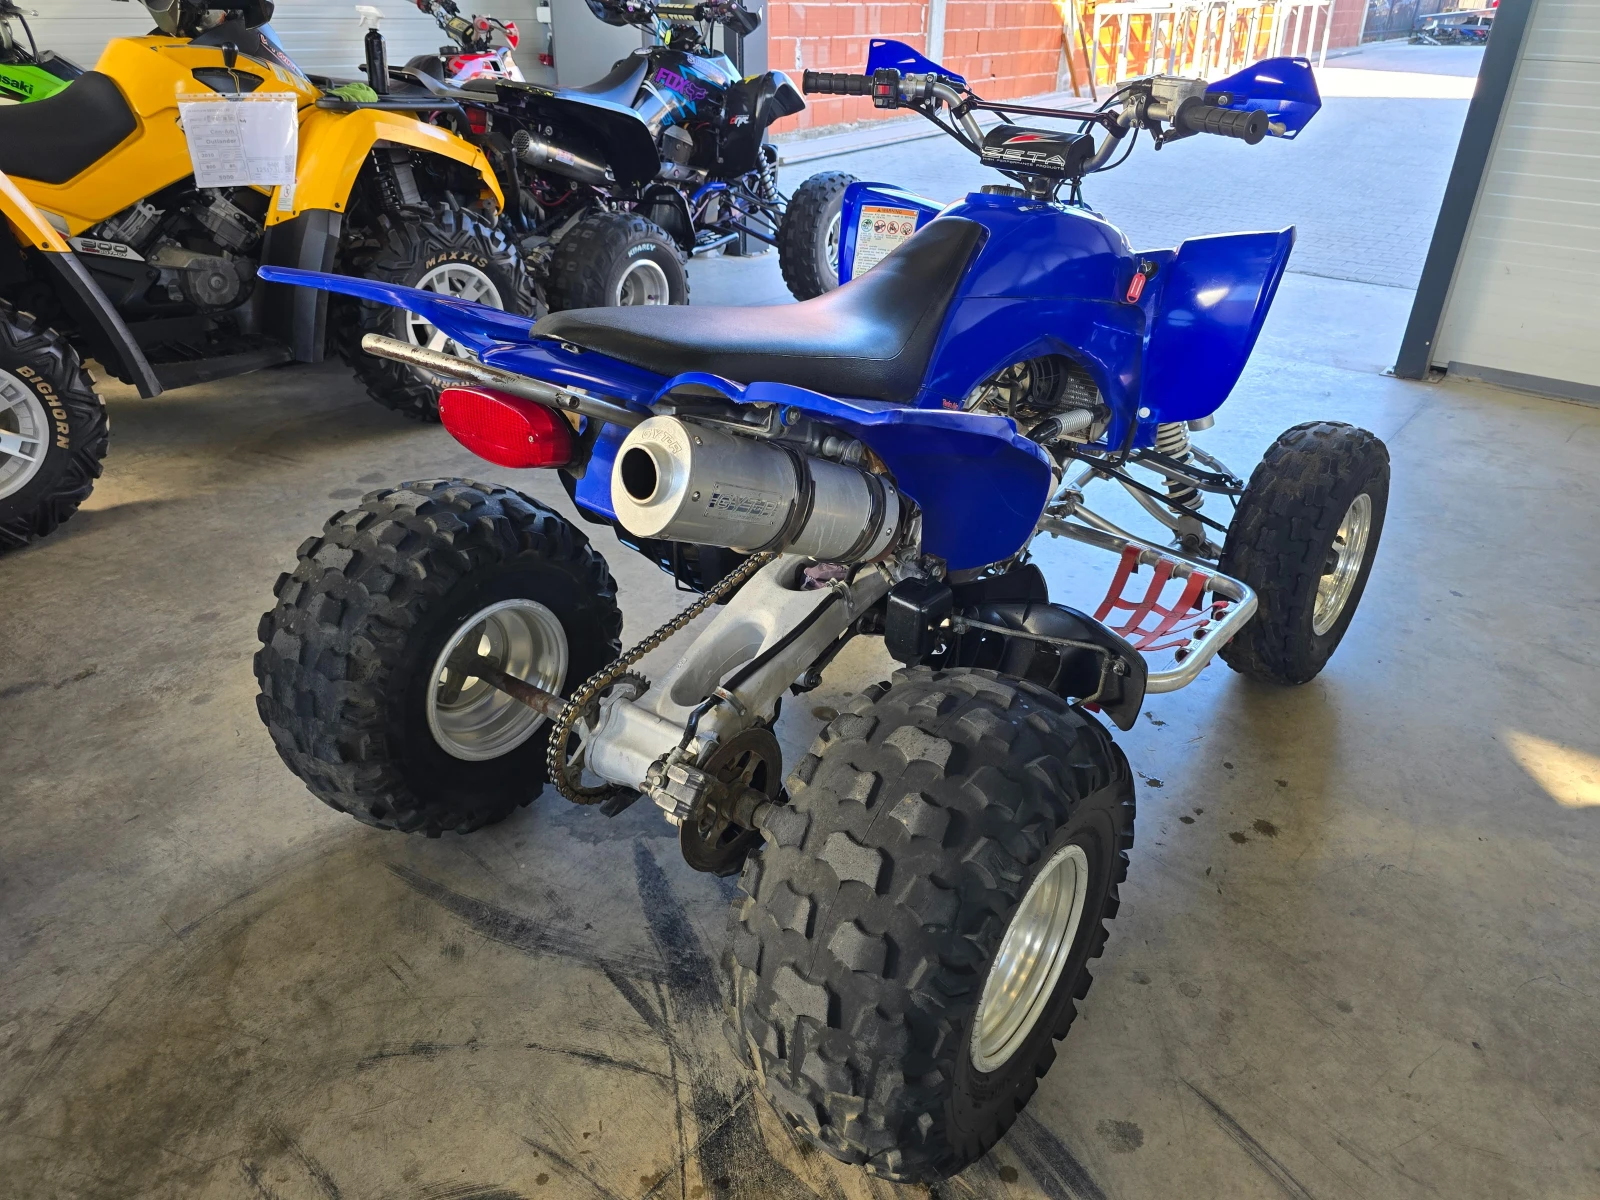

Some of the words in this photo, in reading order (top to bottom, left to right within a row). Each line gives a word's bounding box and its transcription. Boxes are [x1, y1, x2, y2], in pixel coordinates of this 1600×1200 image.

[0, 75, 34, 94] saki
[655, 67, 690, 95] FOX
[982, 146, 1066, 167] ZETA
[1036, 163, 1065, 171] PRODUCTS
[426, 251, 489, 269] MAXXIS
[16, 366, 70, 449] BIGHORN
